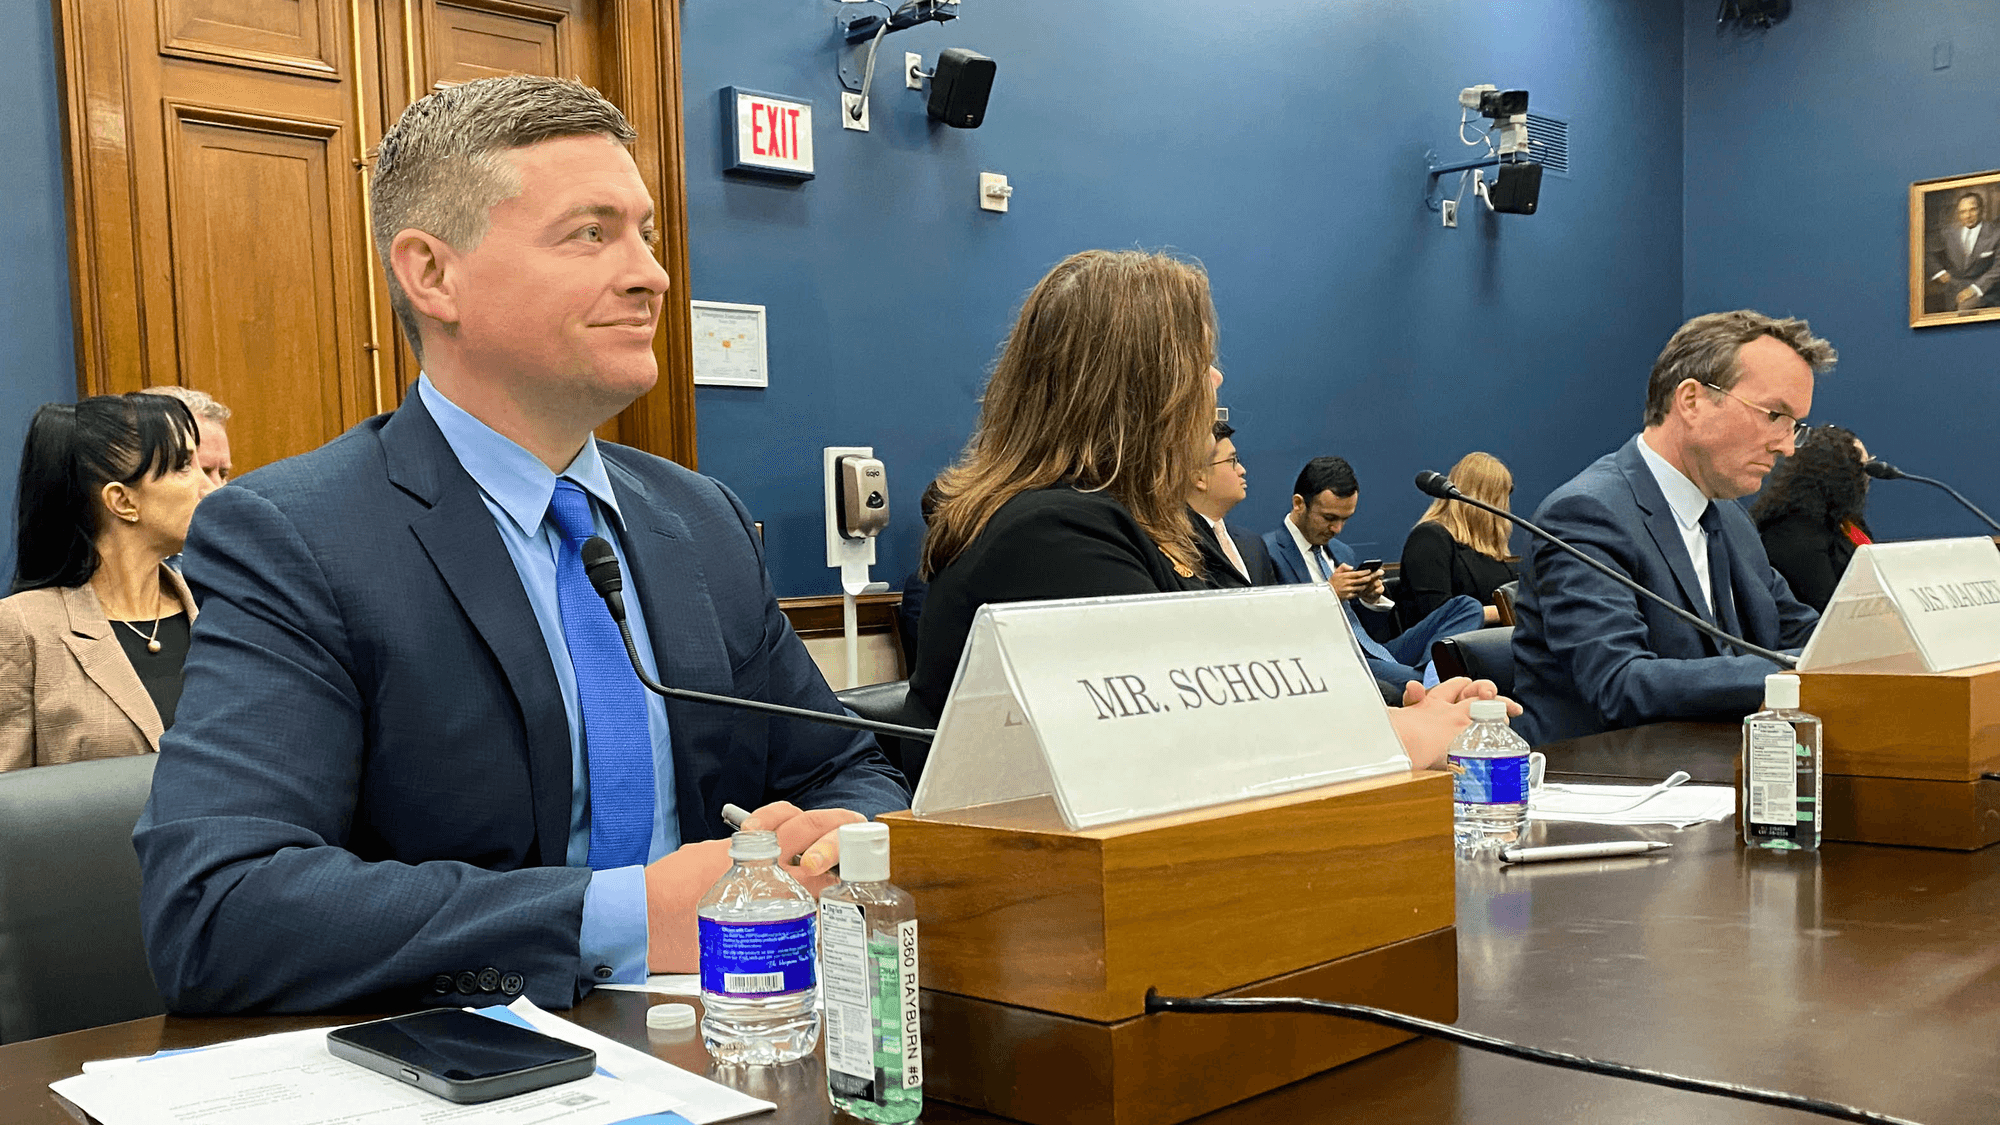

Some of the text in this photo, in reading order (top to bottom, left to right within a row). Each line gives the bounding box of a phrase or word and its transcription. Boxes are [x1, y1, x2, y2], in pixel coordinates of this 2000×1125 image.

[751, 102, 800, 160] EXIT
[1909, 586, 1949, 612] MS.
[1077, 657, 1329, 720] MR. SCHOLL
[903, 926, 920, 1086] 2360 RAYBURN #6
